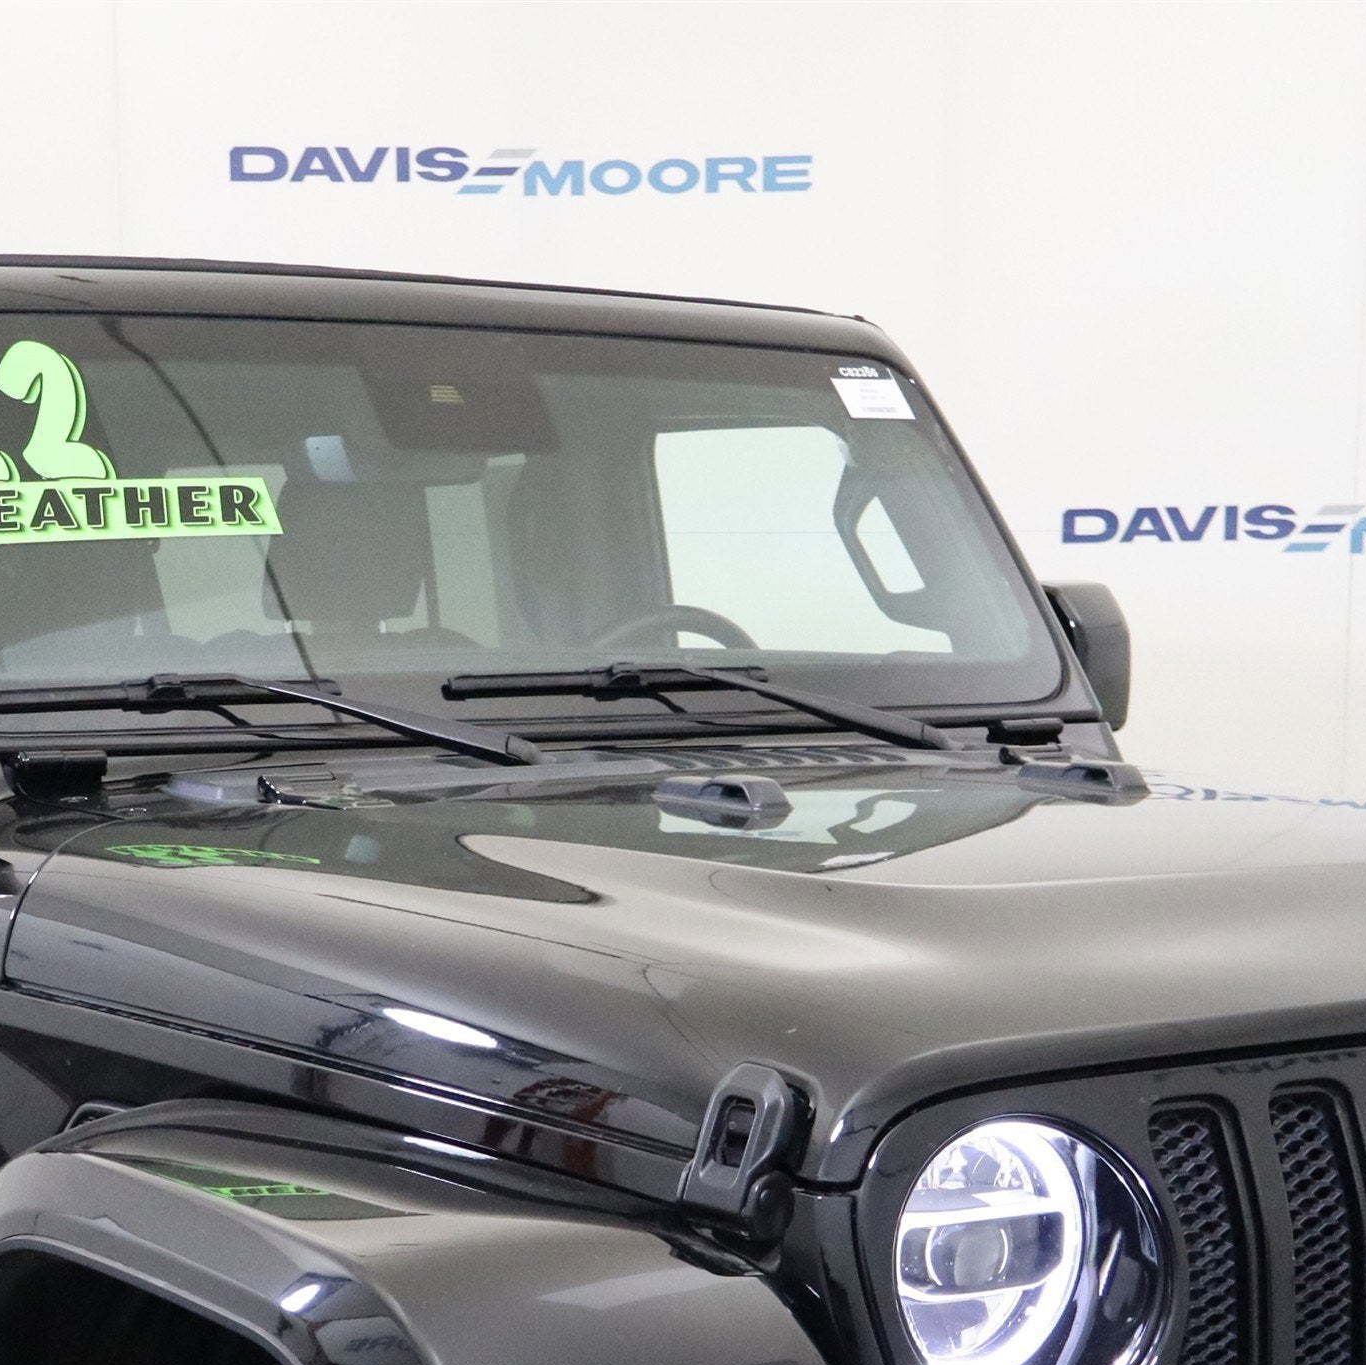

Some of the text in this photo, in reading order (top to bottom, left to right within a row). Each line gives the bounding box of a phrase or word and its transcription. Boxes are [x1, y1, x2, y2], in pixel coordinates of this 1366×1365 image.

[229, 145, 812, 197] DAVIS MOORE
[1061, 504, 1298, 545] DAVIS
